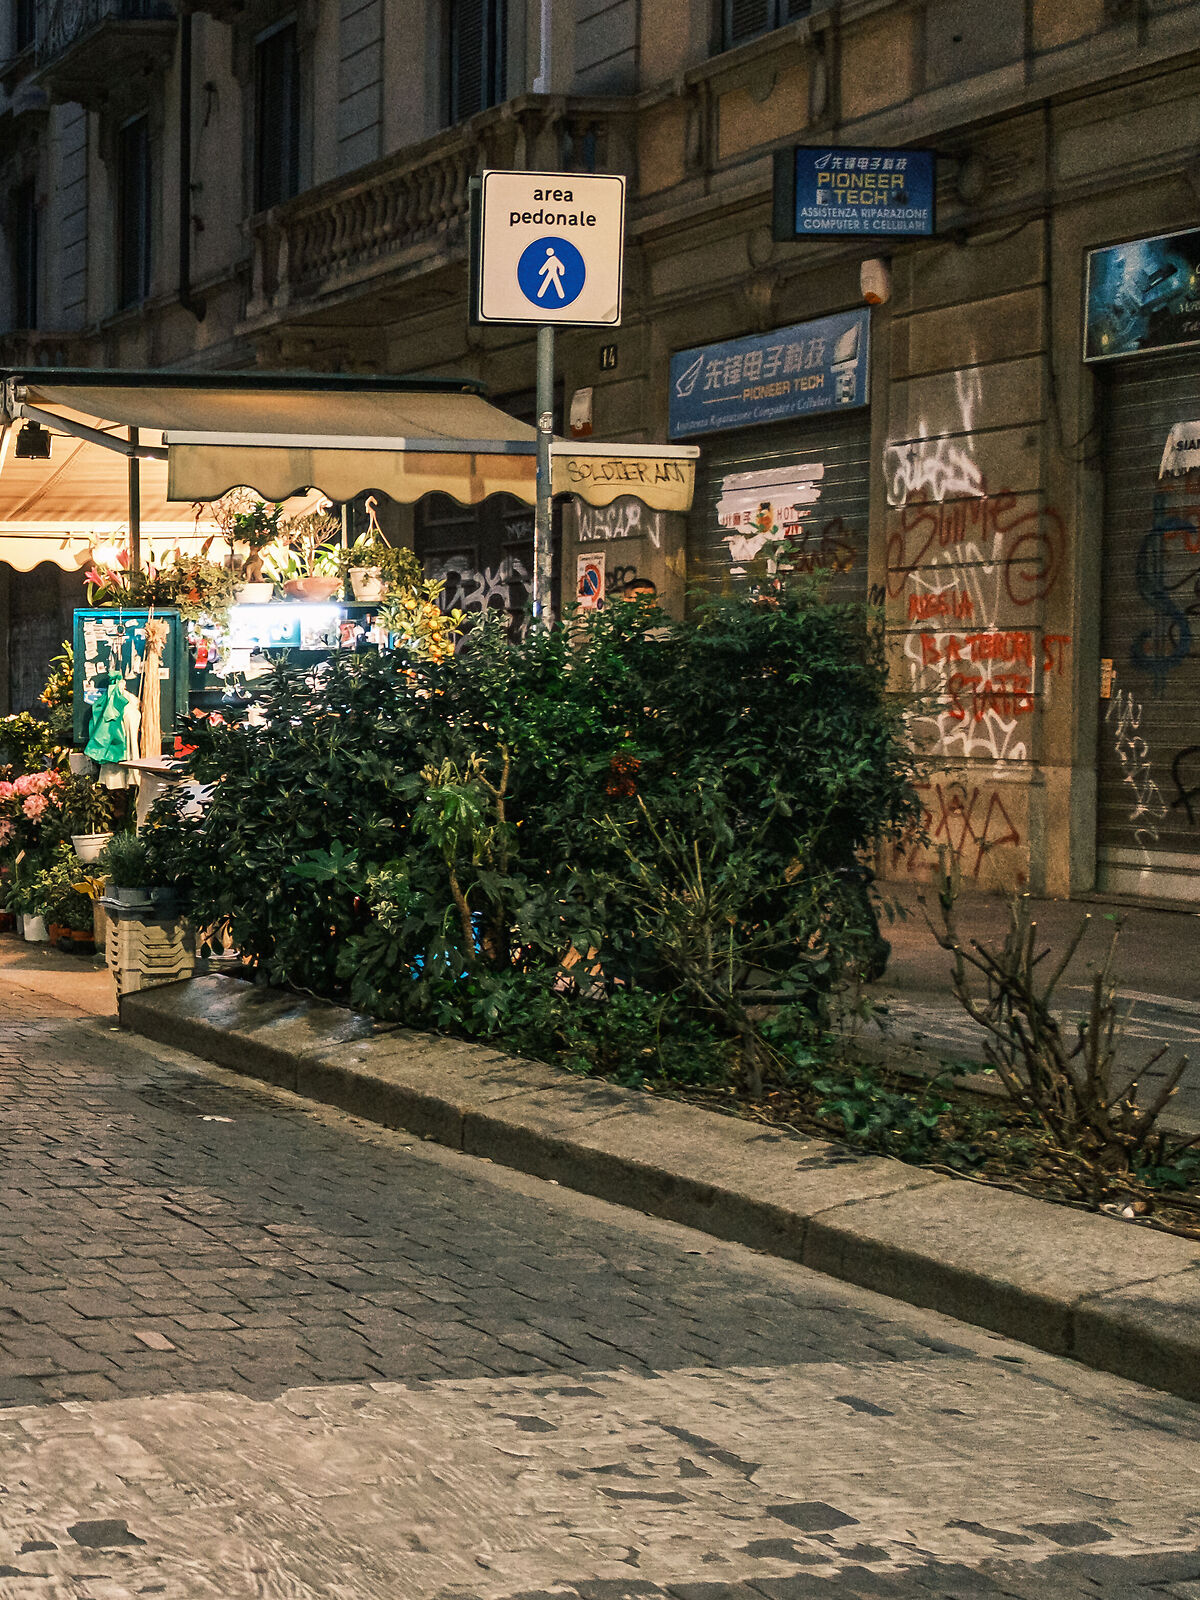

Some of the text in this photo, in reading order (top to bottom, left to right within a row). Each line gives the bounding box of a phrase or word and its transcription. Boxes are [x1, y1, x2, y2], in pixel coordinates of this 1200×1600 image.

[817, 172, 904, 188] PIONEER
[533, 189, 573, 202] area
[834, 189, 888, 205] TECH
[509, 209, 596, 226] pedonale
[801, 208, 928, 219] ASSISTENZA RIPARAZIONE
[804, 219, 860, 229] COMPUTER
[863, 220, 869, 230] E
[742, 373, 825, 401] PIONEER TECH
[568, 461, 648, 483] SOLDIER
